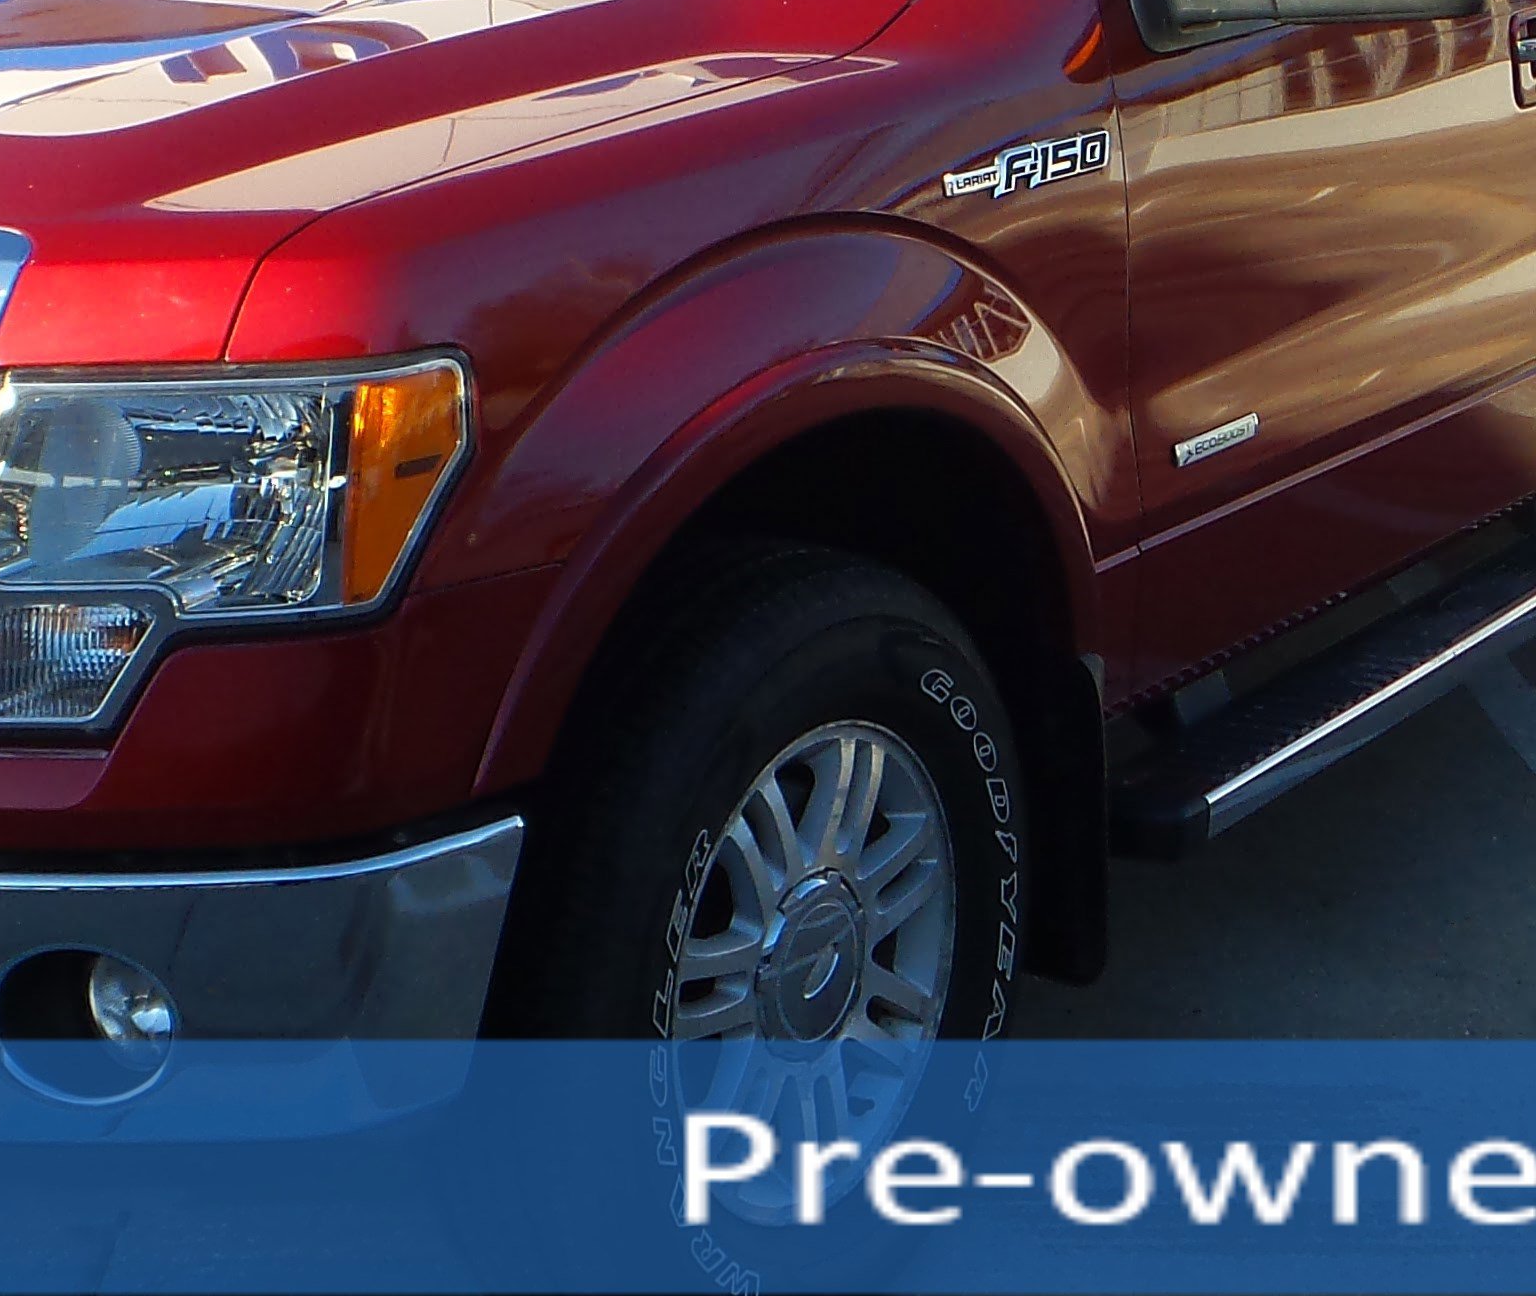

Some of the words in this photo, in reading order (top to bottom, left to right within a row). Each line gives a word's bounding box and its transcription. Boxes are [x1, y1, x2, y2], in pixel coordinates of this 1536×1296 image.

[956, 169, 999, 191] LARIAT
[649, 828, 762, 1296] WRANGLER
[920, 668, 1018, 1113] GOODYEAR
